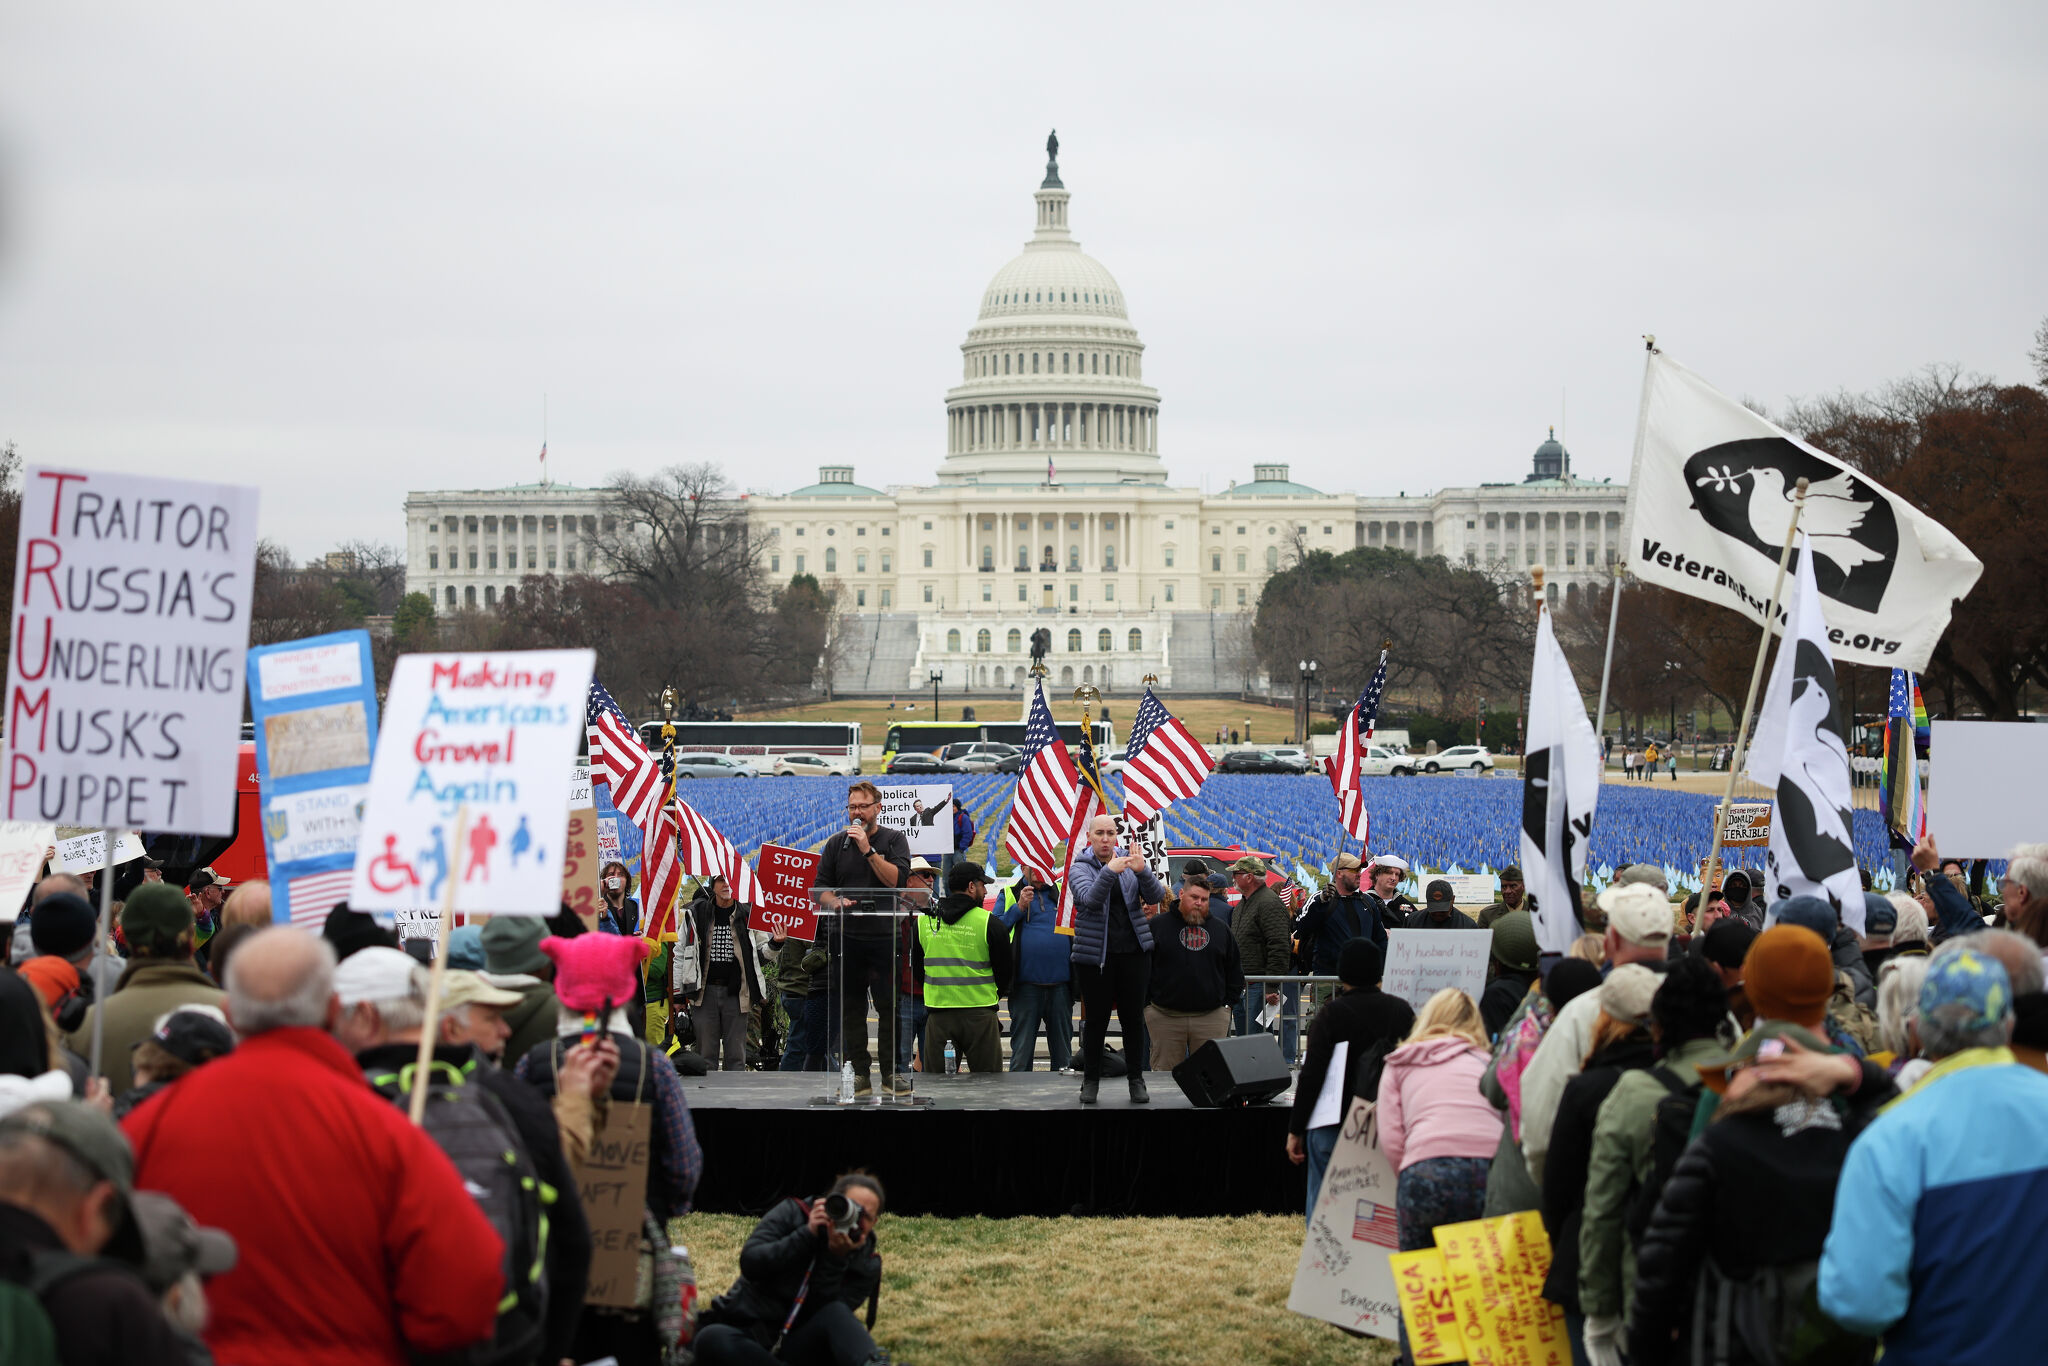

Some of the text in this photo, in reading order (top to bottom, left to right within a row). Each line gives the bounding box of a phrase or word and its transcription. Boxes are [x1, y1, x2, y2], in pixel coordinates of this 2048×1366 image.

[38, 471, 230, 552] TRAITOR
[22, 538, 236, 623] RUSSIA'S
[1641, 538, 1902, 655] VeteransForPe.org
[17, 613, 233, 693] UNDERLING
[265, 674, 353, 695] CONSTITUTION
[430, 660, 557, 698] Making
[421, 691, 569, 726] Americans
[10, 684, 186, 760] MUSK'S
[412, 727, 516, 764] Grovel
[7, 752, 188, 826] PUPPET
[405, 766, 518, 818] Again
[882, 789, 917, 799] bolical
[295, 794, 350, 813] STAND
[880, 803, 910, 814] garch
[877, 816, 906, 826] ifting
[1724, 828, 1767, 839] TERRIBLE
[1123, 833, 1149, 844] THE
[773, 853, 812, 869] STOP
[776, 873, 804, 888] THE
[762, 891, 816, 911] ASCIST
[396, 922, 442, 939] TRUM
[762, 911, 804, 928] COUP
[1396, 942, 1479, 962] My husband has
[1390, 964, 1483, 979] more honor in his
[1414, 978, 1440, 997] finge
[590, 1141, 647, 1166] MOVE
[582, 1181, 628, 1207] AFT
[591, 1229, 640, 1251] GER
[1511, 1217, 1535, 1277] AGAINST
[1468, 1237, 1500, 1313] VETERAN
[1528, 1243, 1564, 1331] TMP!
[1429, 1275, 1456, 1325] IS:
[1510, 1264, 1534, 1326] HITLER
[1403, 1263, 1445, 1358] AMERICA
[1528, 1283, 1555, 1344] FIGHT
